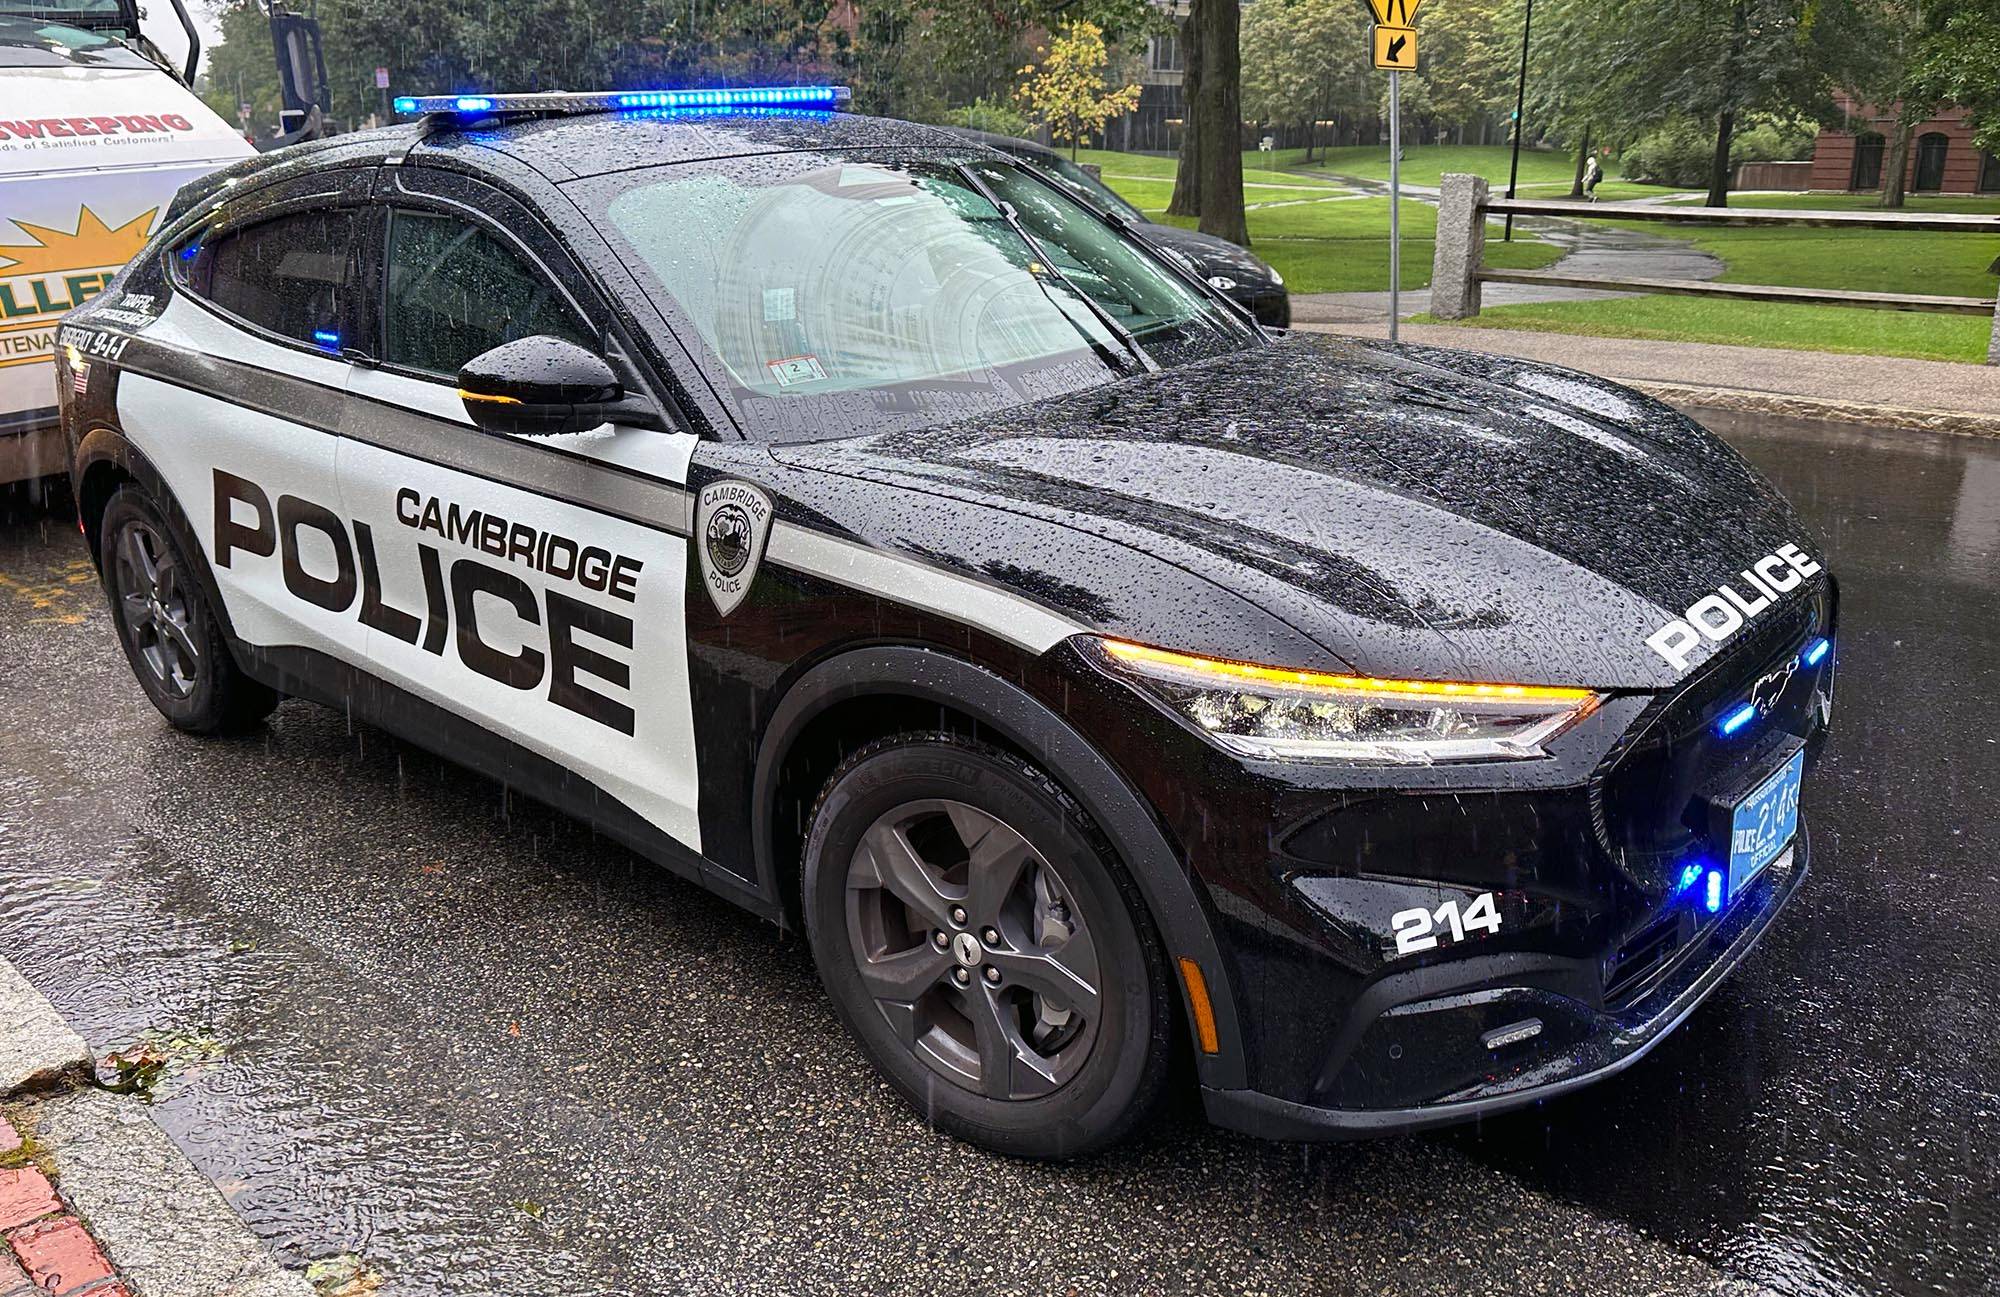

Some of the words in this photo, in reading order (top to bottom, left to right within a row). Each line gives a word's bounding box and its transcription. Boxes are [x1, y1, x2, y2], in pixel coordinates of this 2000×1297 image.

[24, 141, 36, 150] of
[42, 139, 97, 149] Satisfied
[104, 134, 174, 146] Customers!
[0, 271, 115, 318] LLE
[0, 333, 56, 355] TENA
[90, 332, 130, 361] 9-1-1
[790, 363, 801, 373] 2
[704, 487, 767, 522] CAMBRIDGE
[396, 487, 644, 604] CAMBRIDGE
[709, 571, 742, 594] POLICE
[212, 467, 635, 739] POLICE
[1644, 542, 1822, 672] POLICE
[1391, 892, 1502, 955] 214
